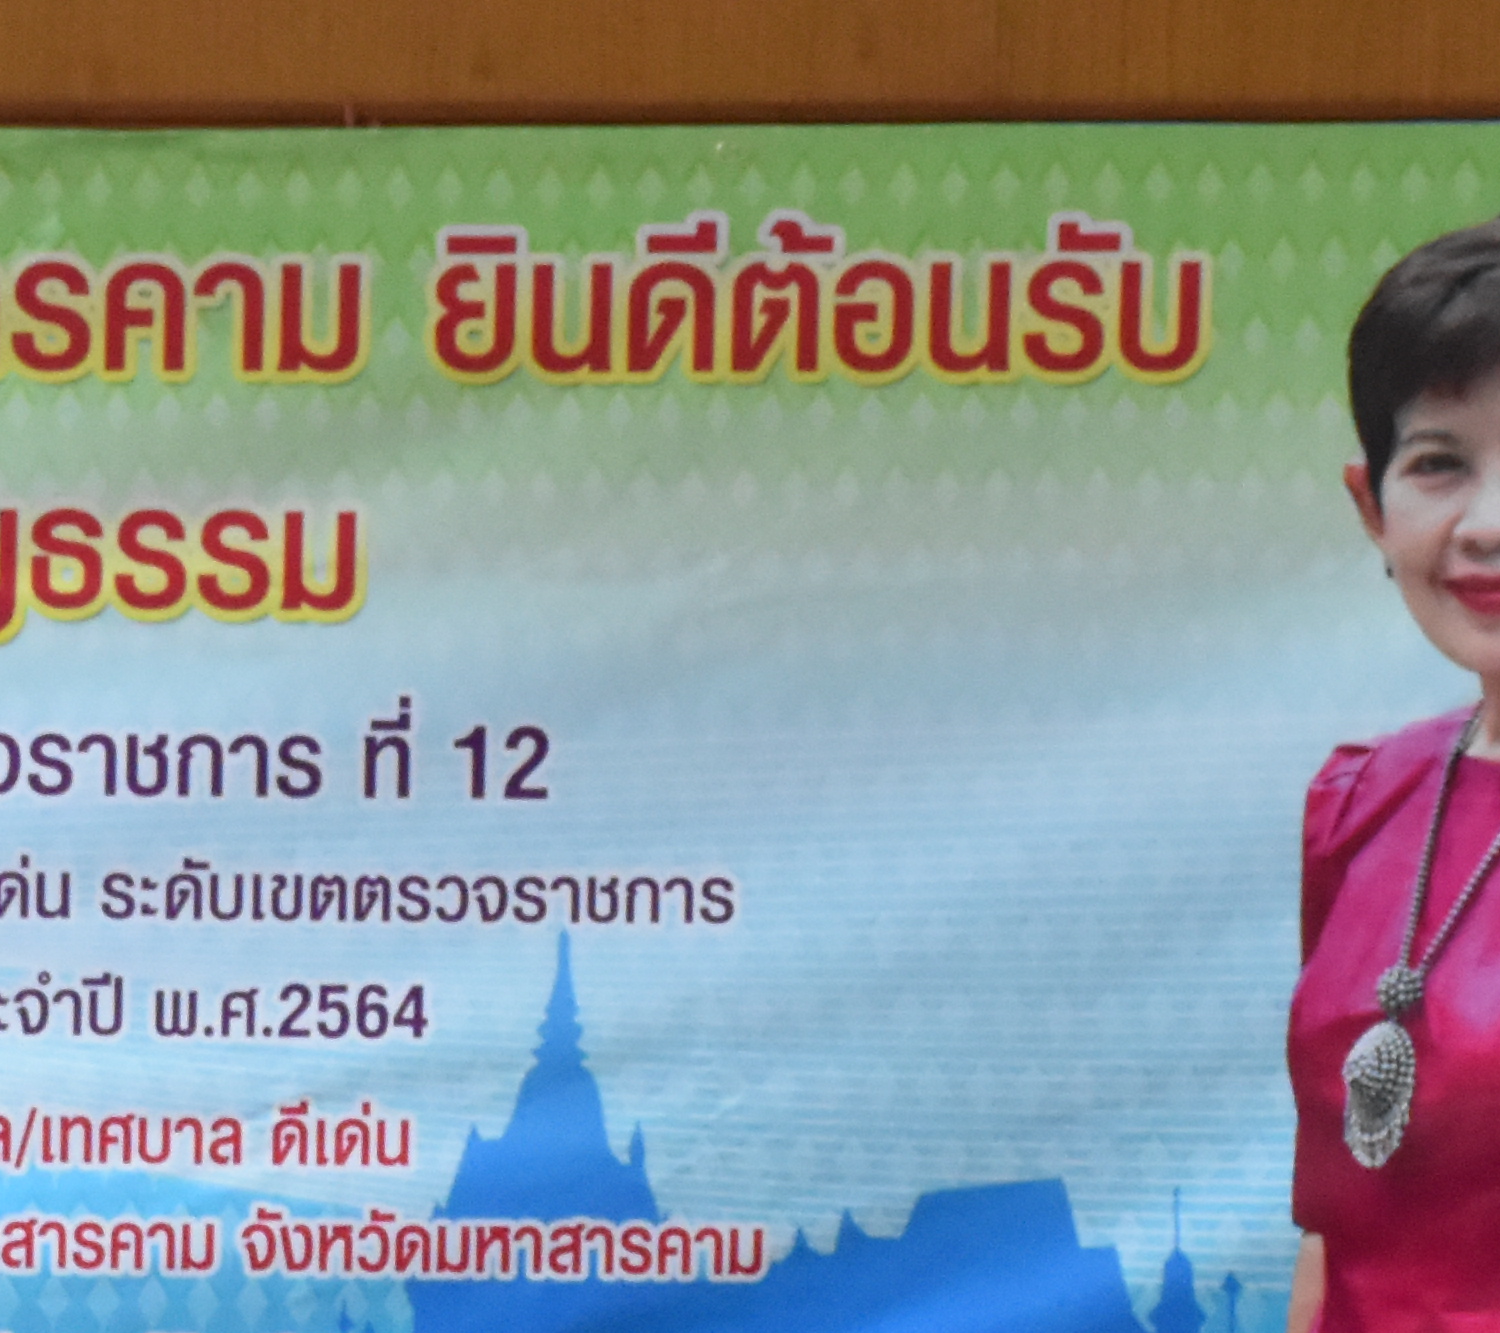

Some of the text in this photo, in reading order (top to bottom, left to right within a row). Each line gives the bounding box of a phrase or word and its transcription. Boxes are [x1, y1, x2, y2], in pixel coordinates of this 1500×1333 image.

[434, 219, 1203, 374] ยินดีต้อนรับ
[363, 695, 413, 799] ที่
[453, 725, 551, 801] 12
[101, 856, 735, 924] ระดับเขตตรวจราชการ
[154, 982, 429, 1039] พ.ศ.2564
[271, 1101, 411, 1167] ดีเด่น
[242, 1207, 765, 1276] จังหวัดมหาสารคาม
